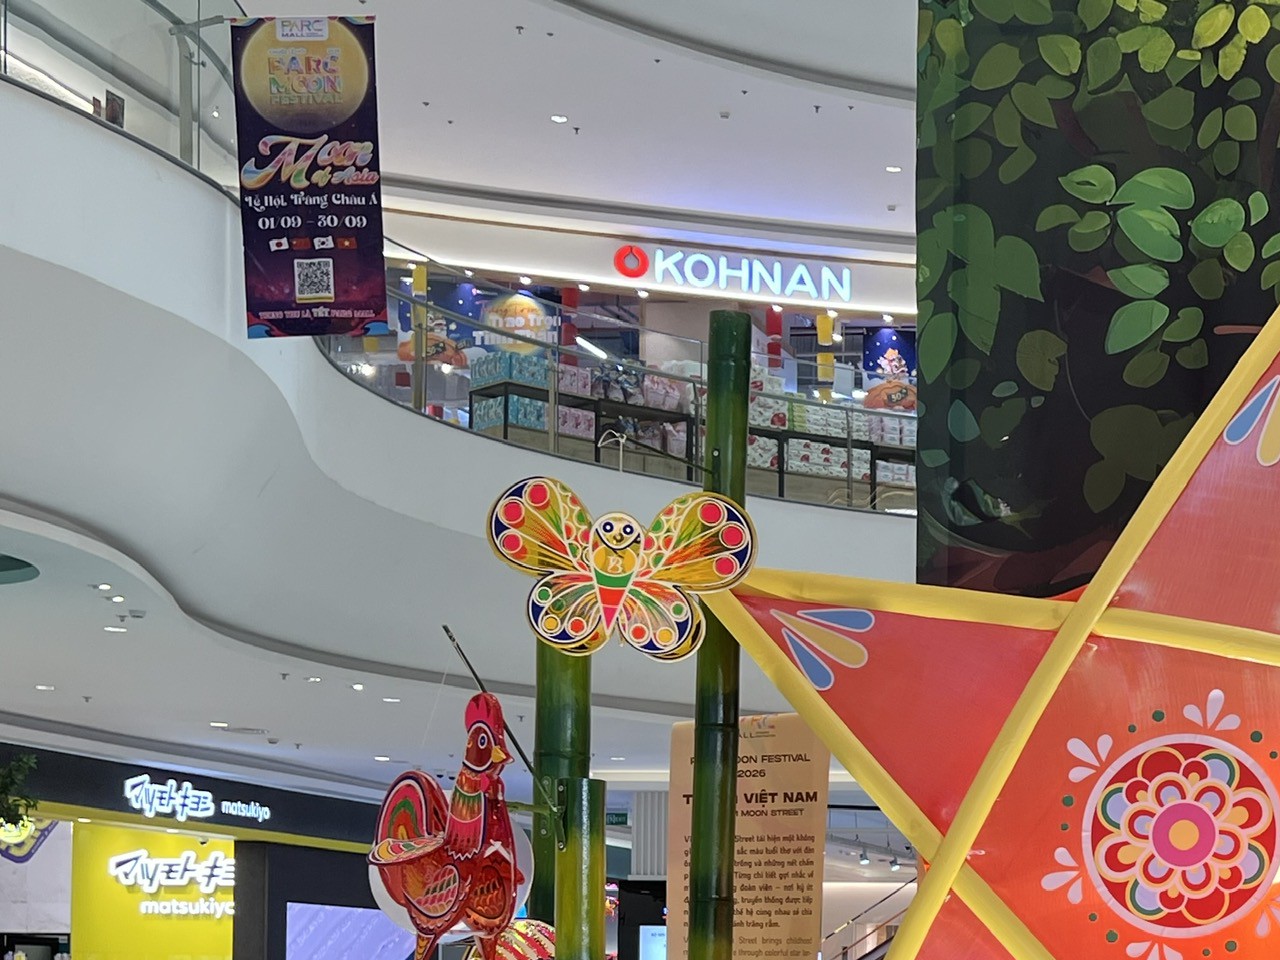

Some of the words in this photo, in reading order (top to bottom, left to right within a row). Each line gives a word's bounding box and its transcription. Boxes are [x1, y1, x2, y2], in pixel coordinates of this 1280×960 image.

[268, 55, 339, 75] PARC
[268, 76, 342, 94] MOON
[258, 216, 302, 230] 01/09
[317, 214, 367, 228] 30/09
[654, 248, 852, 302] KOHNAN
[737, 755, 758, 764] OON
[762, 753, 811, 763] FESTIVAL
[737, 769, 766, 778] 2026
[744, 788, 778, 808] VIỆT
[784, 791, 818, 803] NAM
[221, 800, 271, 822] matsukiyo
[740, 808, 768, 817] MOON
[770, 808, 804, 816] STREET
